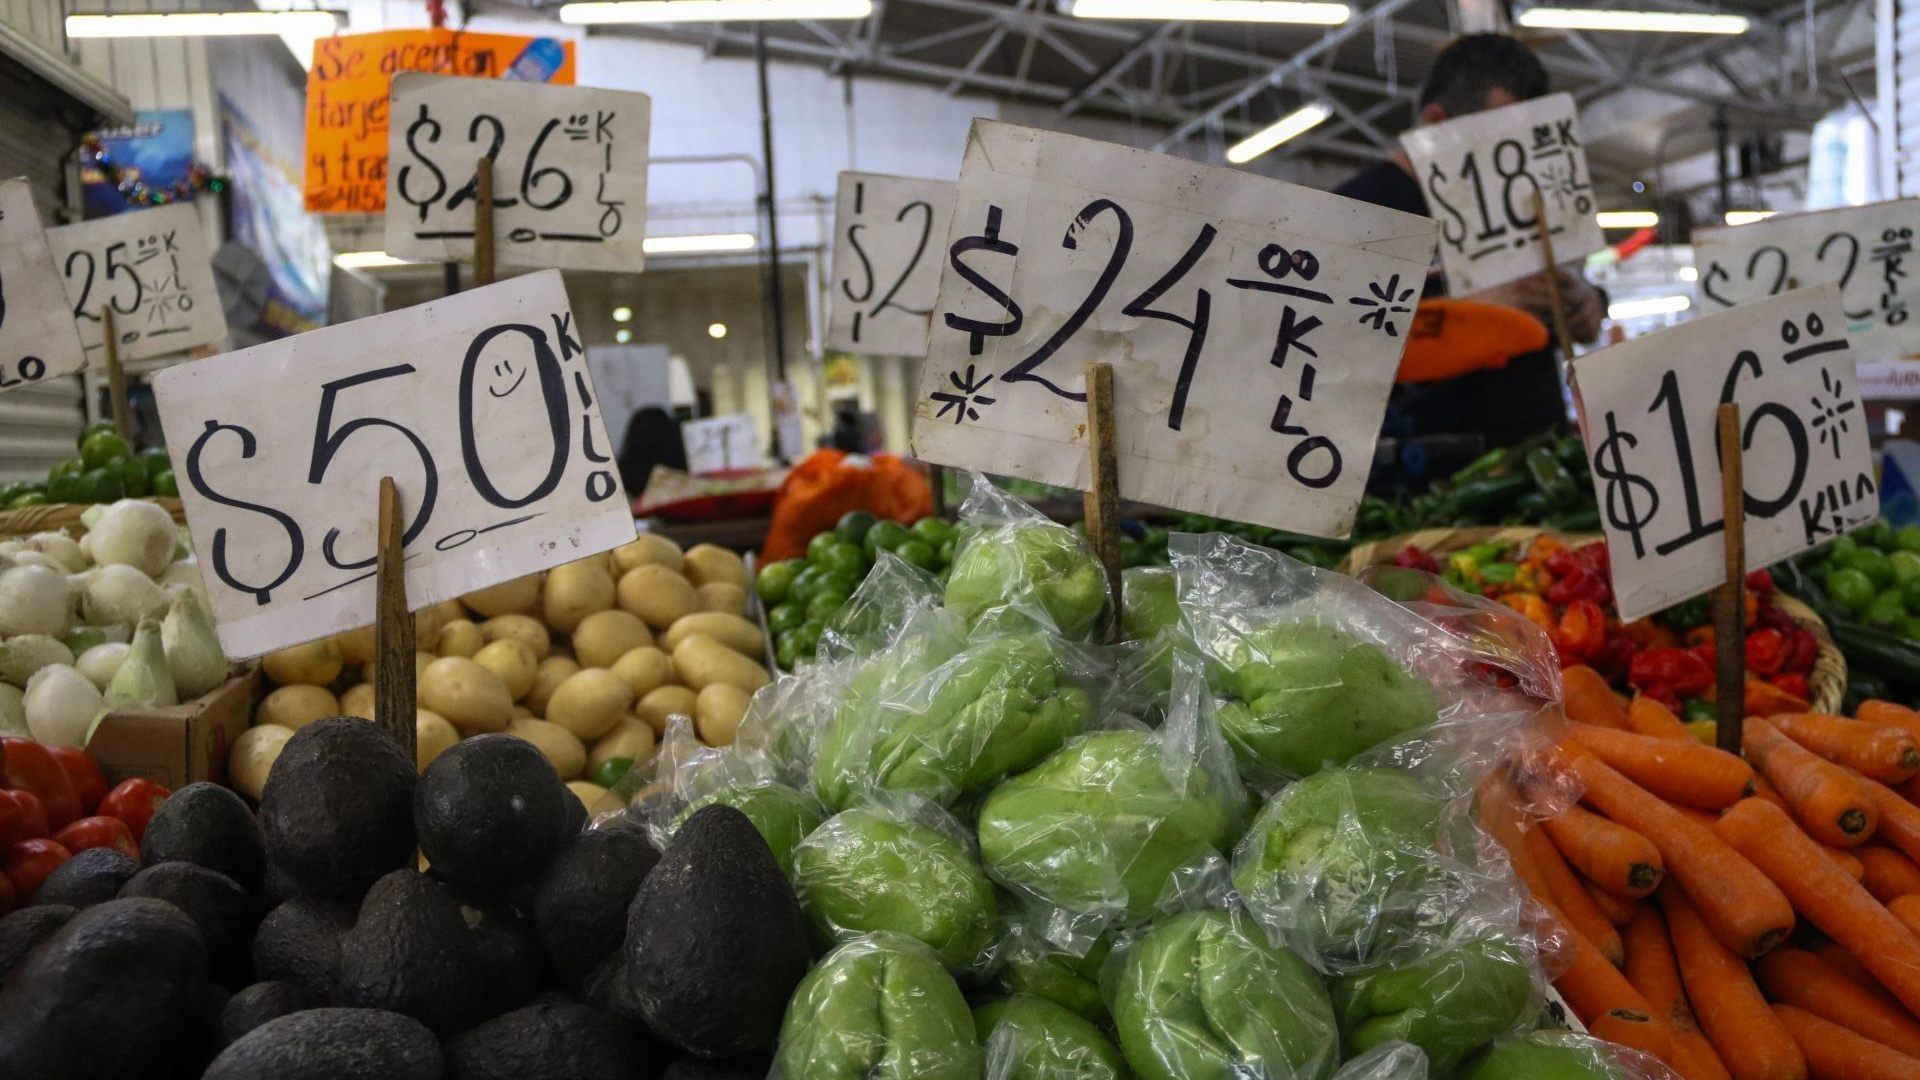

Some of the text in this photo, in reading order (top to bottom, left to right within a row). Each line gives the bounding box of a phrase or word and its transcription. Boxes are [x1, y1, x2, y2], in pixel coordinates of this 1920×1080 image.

[314, 90, 390, 142] tarje
[317, 39, 365, 80] Se
[341, 141, 389, 181] tra
[397, 104, 573, 223] $26
[596, 110, 625, 237] KILO
[1427, 139, 1542, 253] $18
[1557, 118, 1592, 214] KILO
[65, 241, 143, 321] 25
[163, 230, 193, 312] KILO
[944, 198, 1320, 431] $24 00
[551, 312, 617, 502] KILO
[1270, 305, 1343, 489] KILO
[1594, 312, 1824, 559] $16 00
[186, 323, 571, 604] $50
